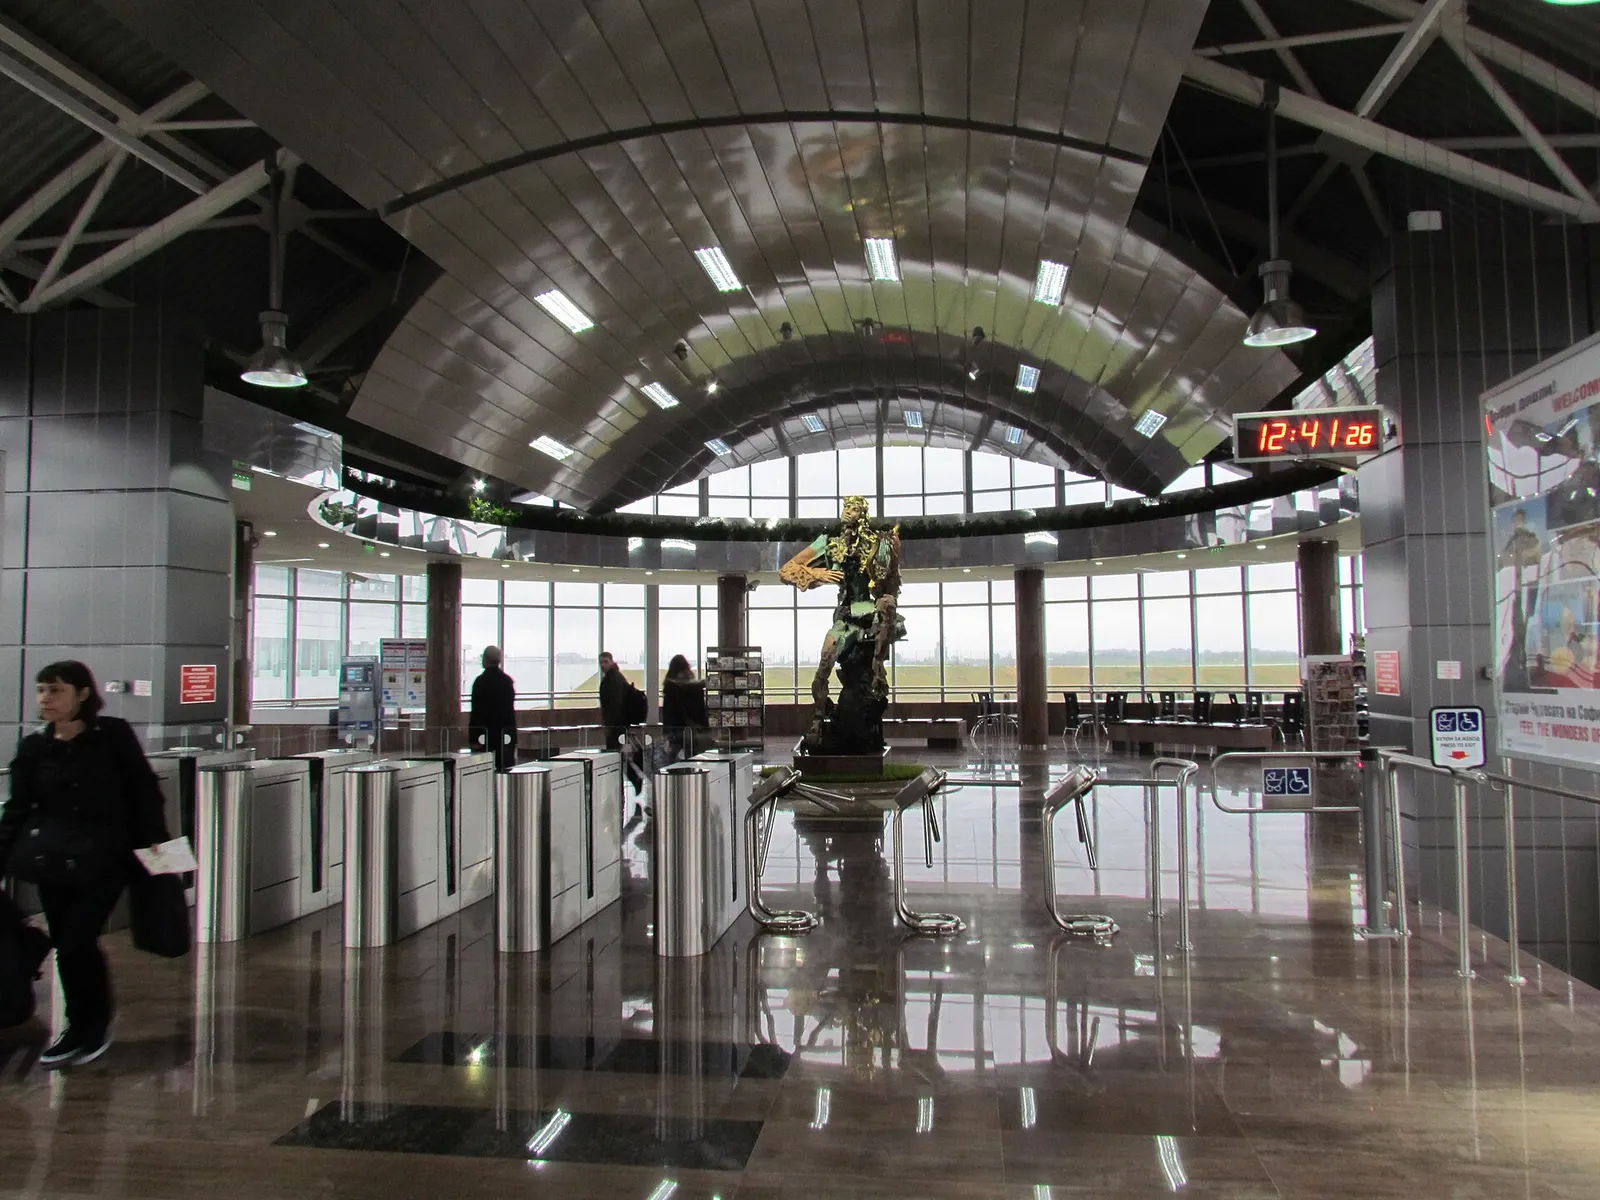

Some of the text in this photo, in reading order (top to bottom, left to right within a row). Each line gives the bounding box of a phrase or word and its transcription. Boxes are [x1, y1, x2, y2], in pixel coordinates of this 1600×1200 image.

[1259, 419, 1373, 451] 12:41 26
[1519, 720, 1535, 735] FEEL
[1537, 722, 1550, 737] THE
[1551, 724, 1589, 742] WONDERS
